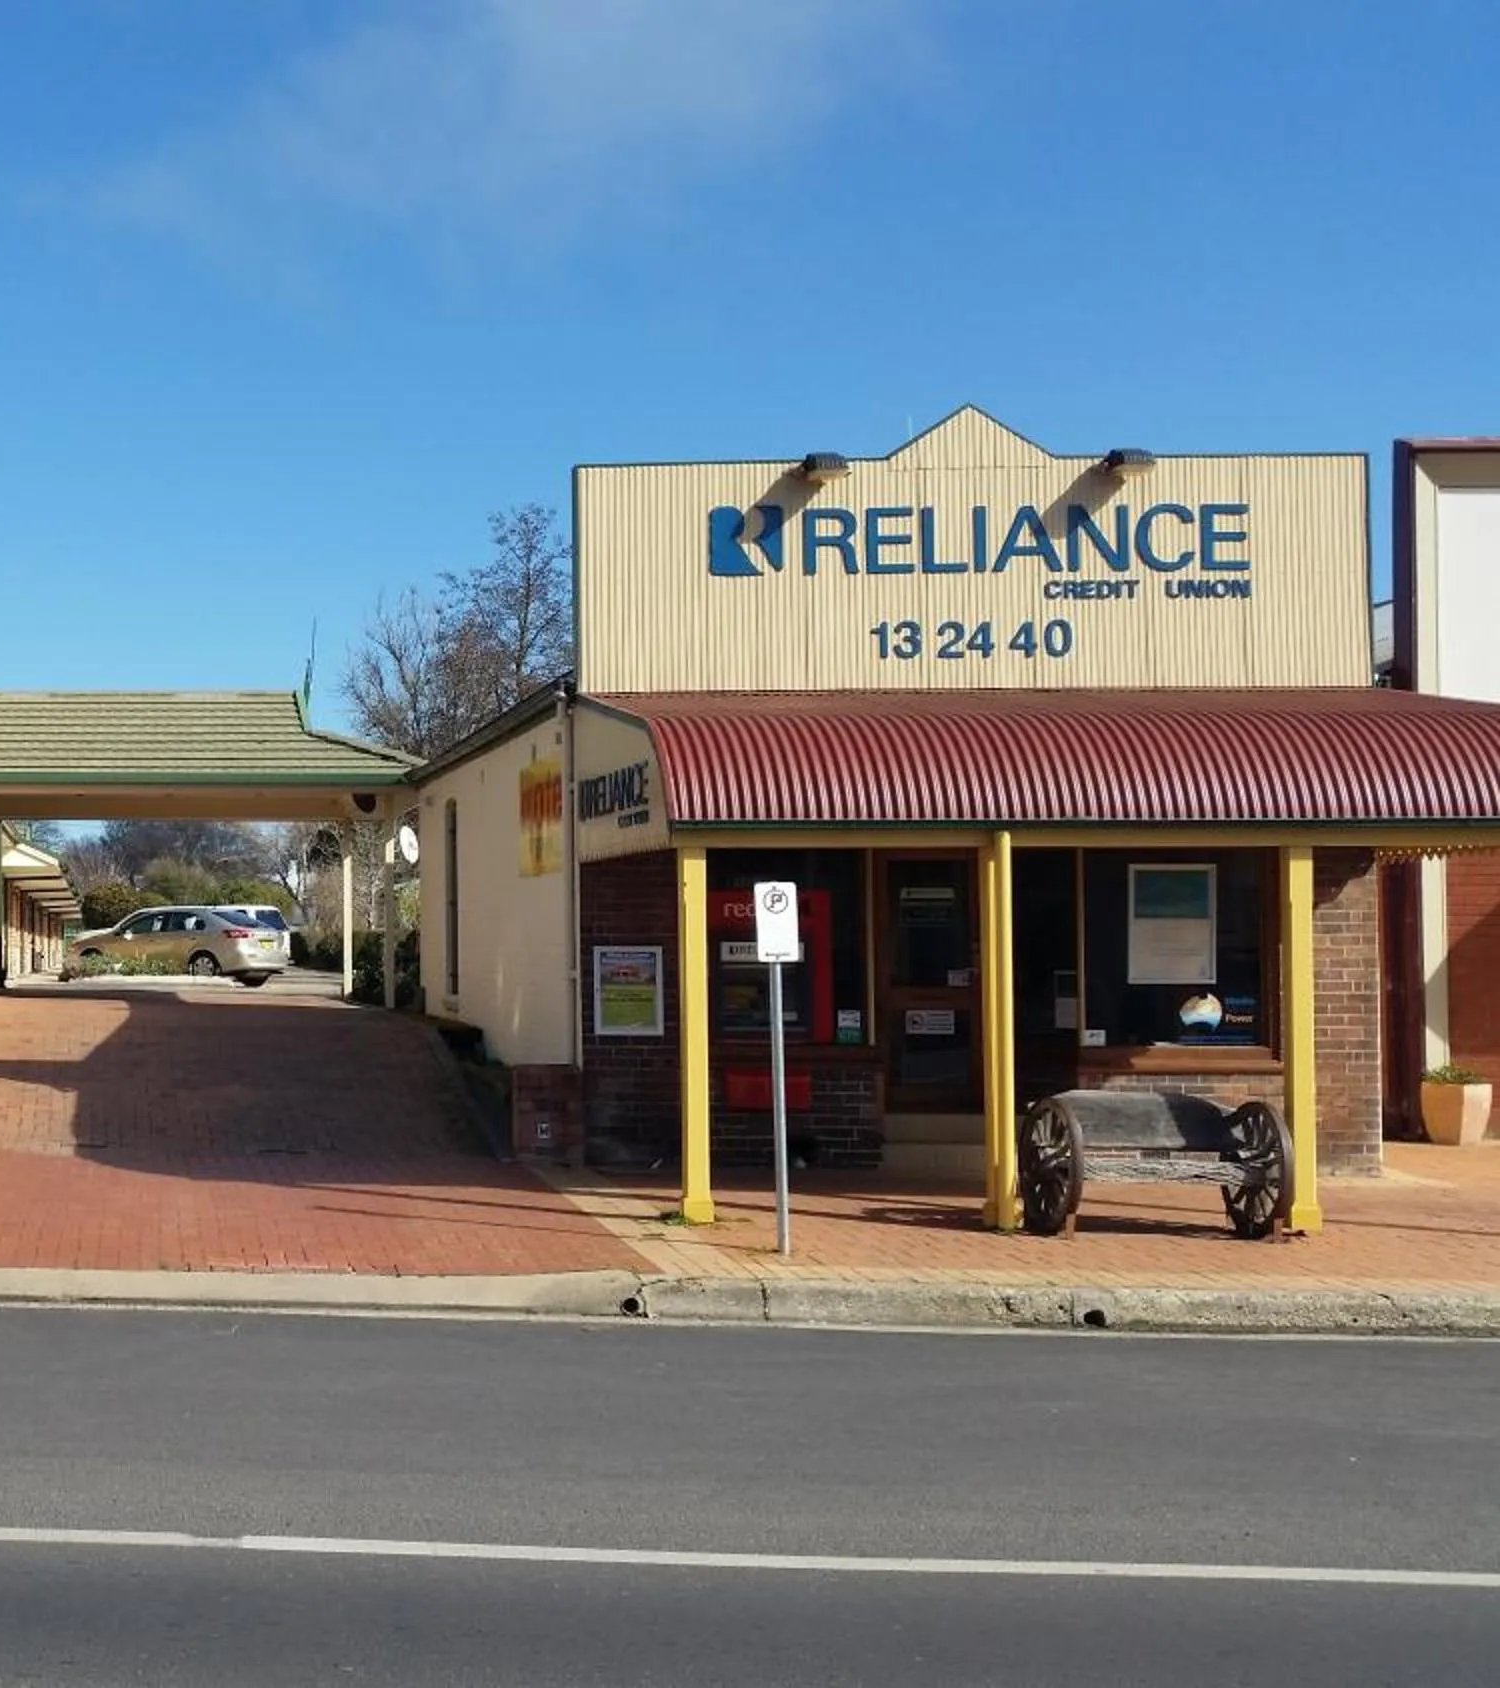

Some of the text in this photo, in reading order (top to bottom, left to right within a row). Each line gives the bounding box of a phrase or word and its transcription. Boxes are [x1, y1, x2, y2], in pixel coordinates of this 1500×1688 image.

[802, 504, 1251, 577] RELIANCE
[1043, 579, 1252, 600] CREDIT UNION
[870, 618, 1073, 660] 13 24 40
